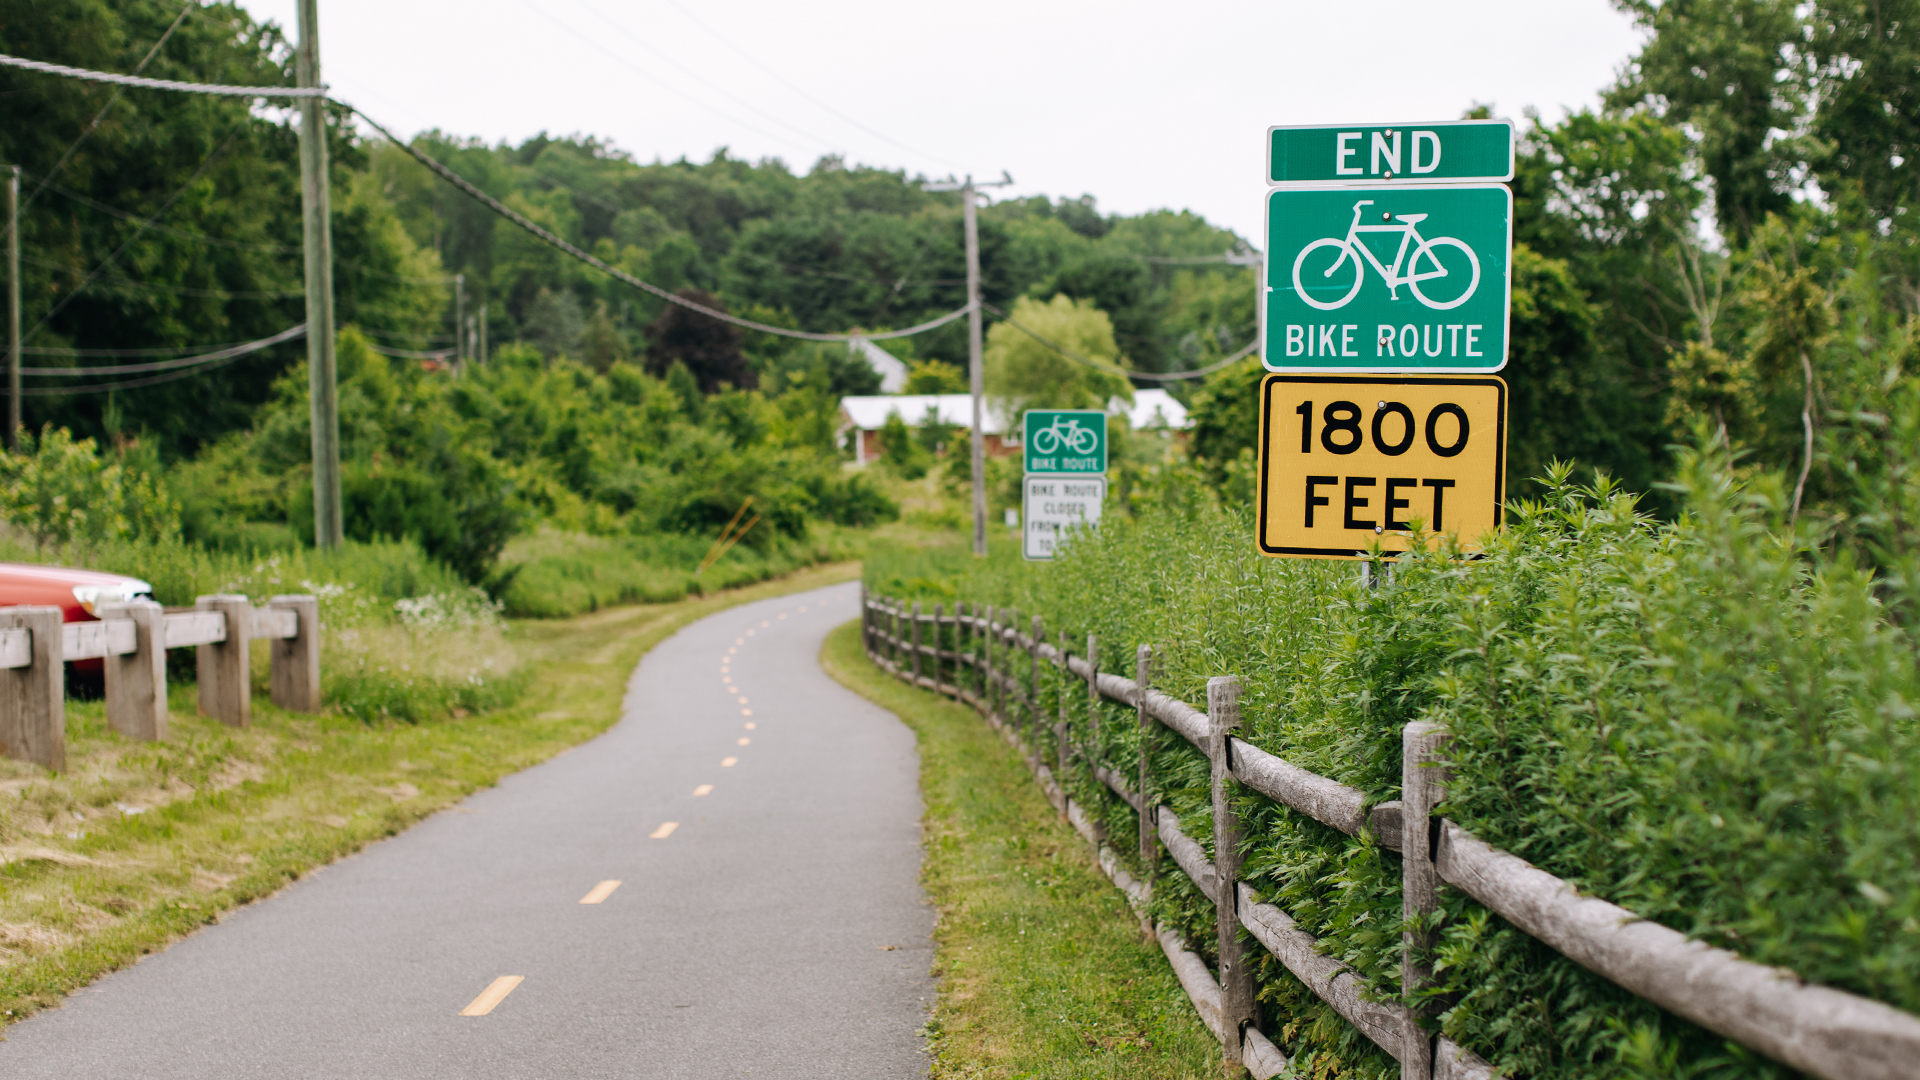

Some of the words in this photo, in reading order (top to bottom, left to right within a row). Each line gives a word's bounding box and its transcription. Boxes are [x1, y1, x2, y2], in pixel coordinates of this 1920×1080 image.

[1336, 131, 1442, 175] END
[1286, 324, 1358, 357] BIKE
[1377, 324, 1483, 357] ROUTE
[1296, 400, 1470, 458] 1800
[1031, 457, 1057, 470] BIKE
[1063, 457, 1098, 470] ROUTE
[1031, 484, 1056, 496] BIKE
[1064, 484, 1098, 497] ROUTE
[1043, 502, 1086, 515] CLOSED
[1305, 475, 1456, 532] FEET
[1031, 520, 1060, 532] FROM
